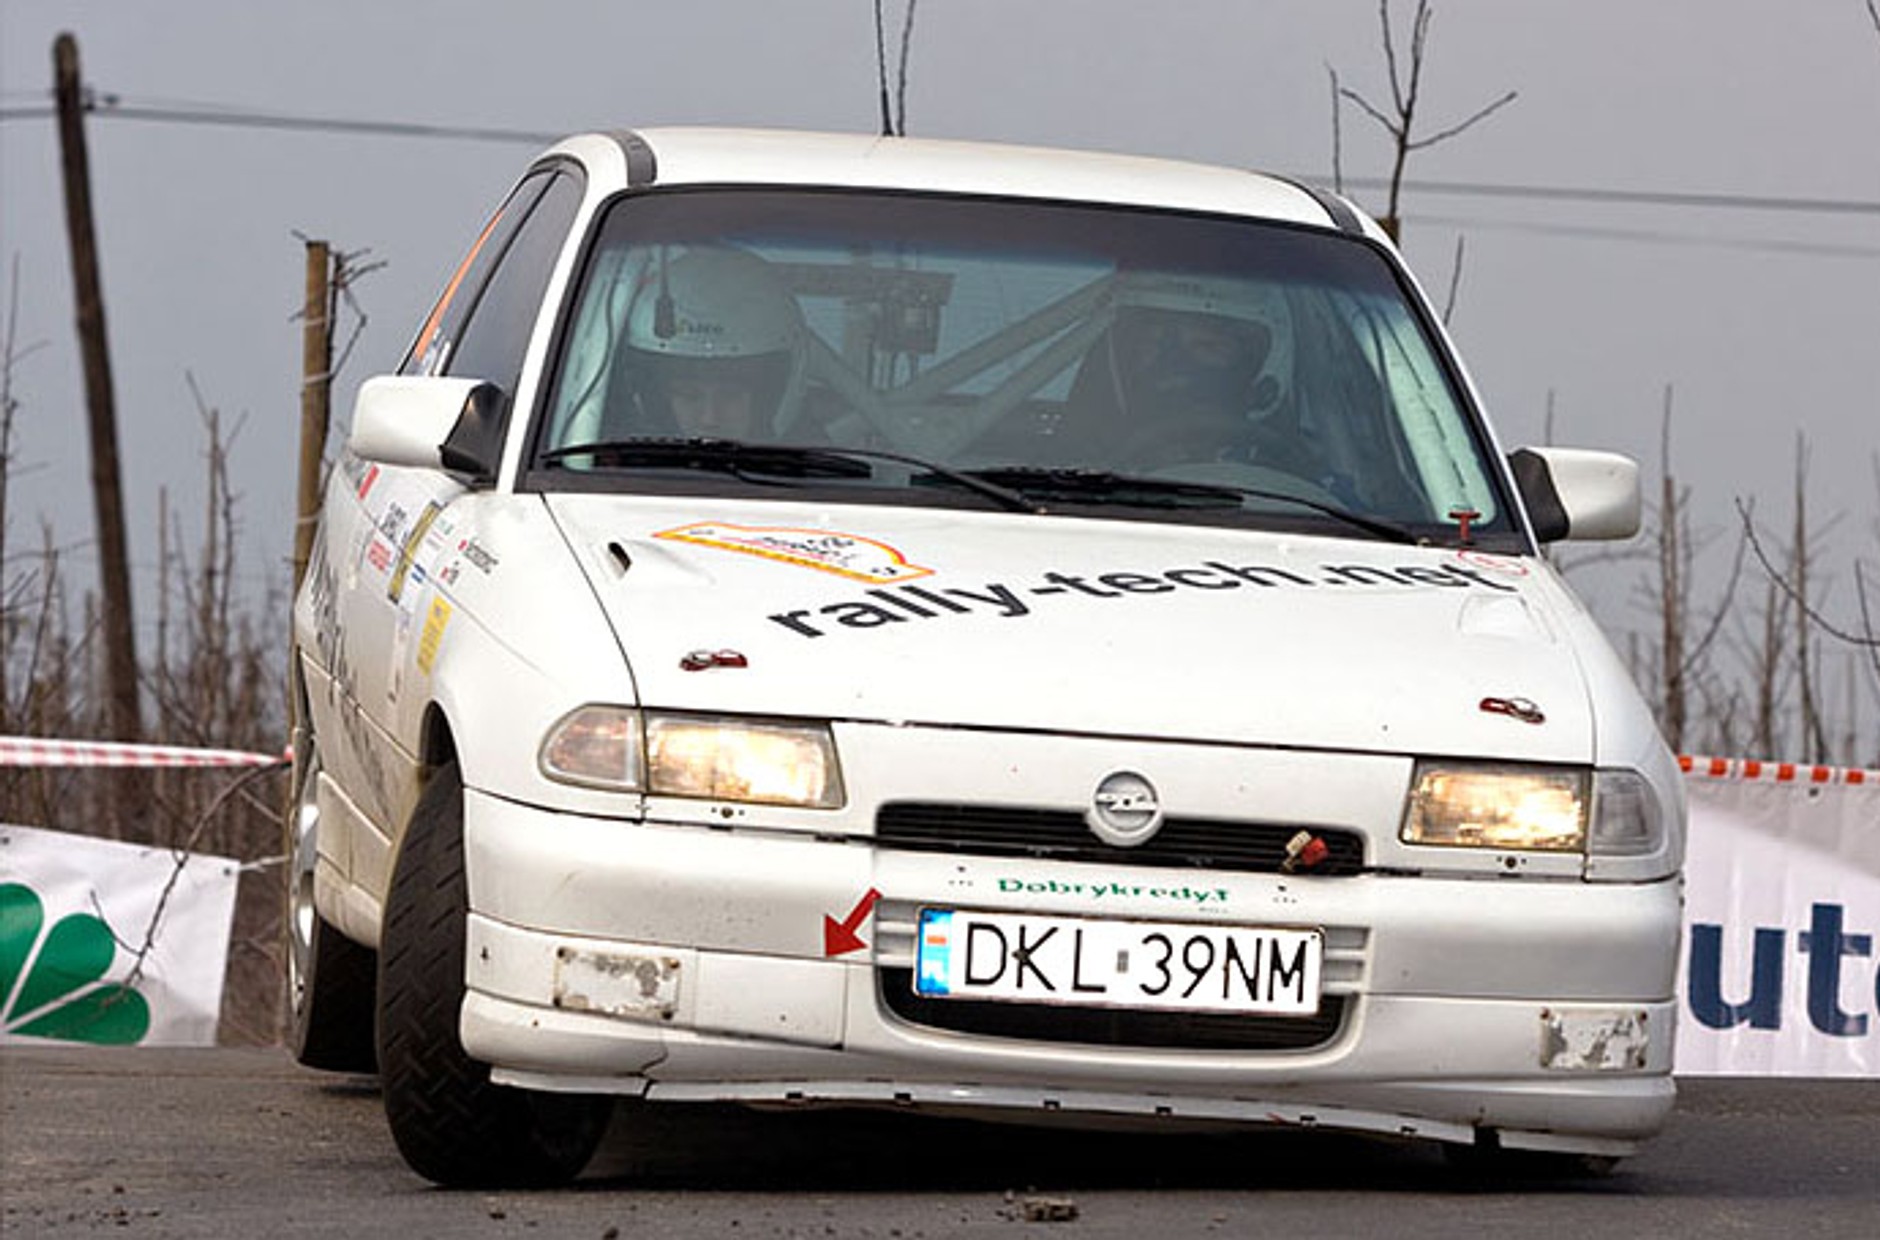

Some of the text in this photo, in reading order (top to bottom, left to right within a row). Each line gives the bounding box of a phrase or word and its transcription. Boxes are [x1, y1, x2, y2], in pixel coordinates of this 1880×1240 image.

[767, 562, 1518, 637] rally-tech.net
[964, 921, 1307, 1003] DKL 39NM
[1688, 903, 1880, 1037] ut
